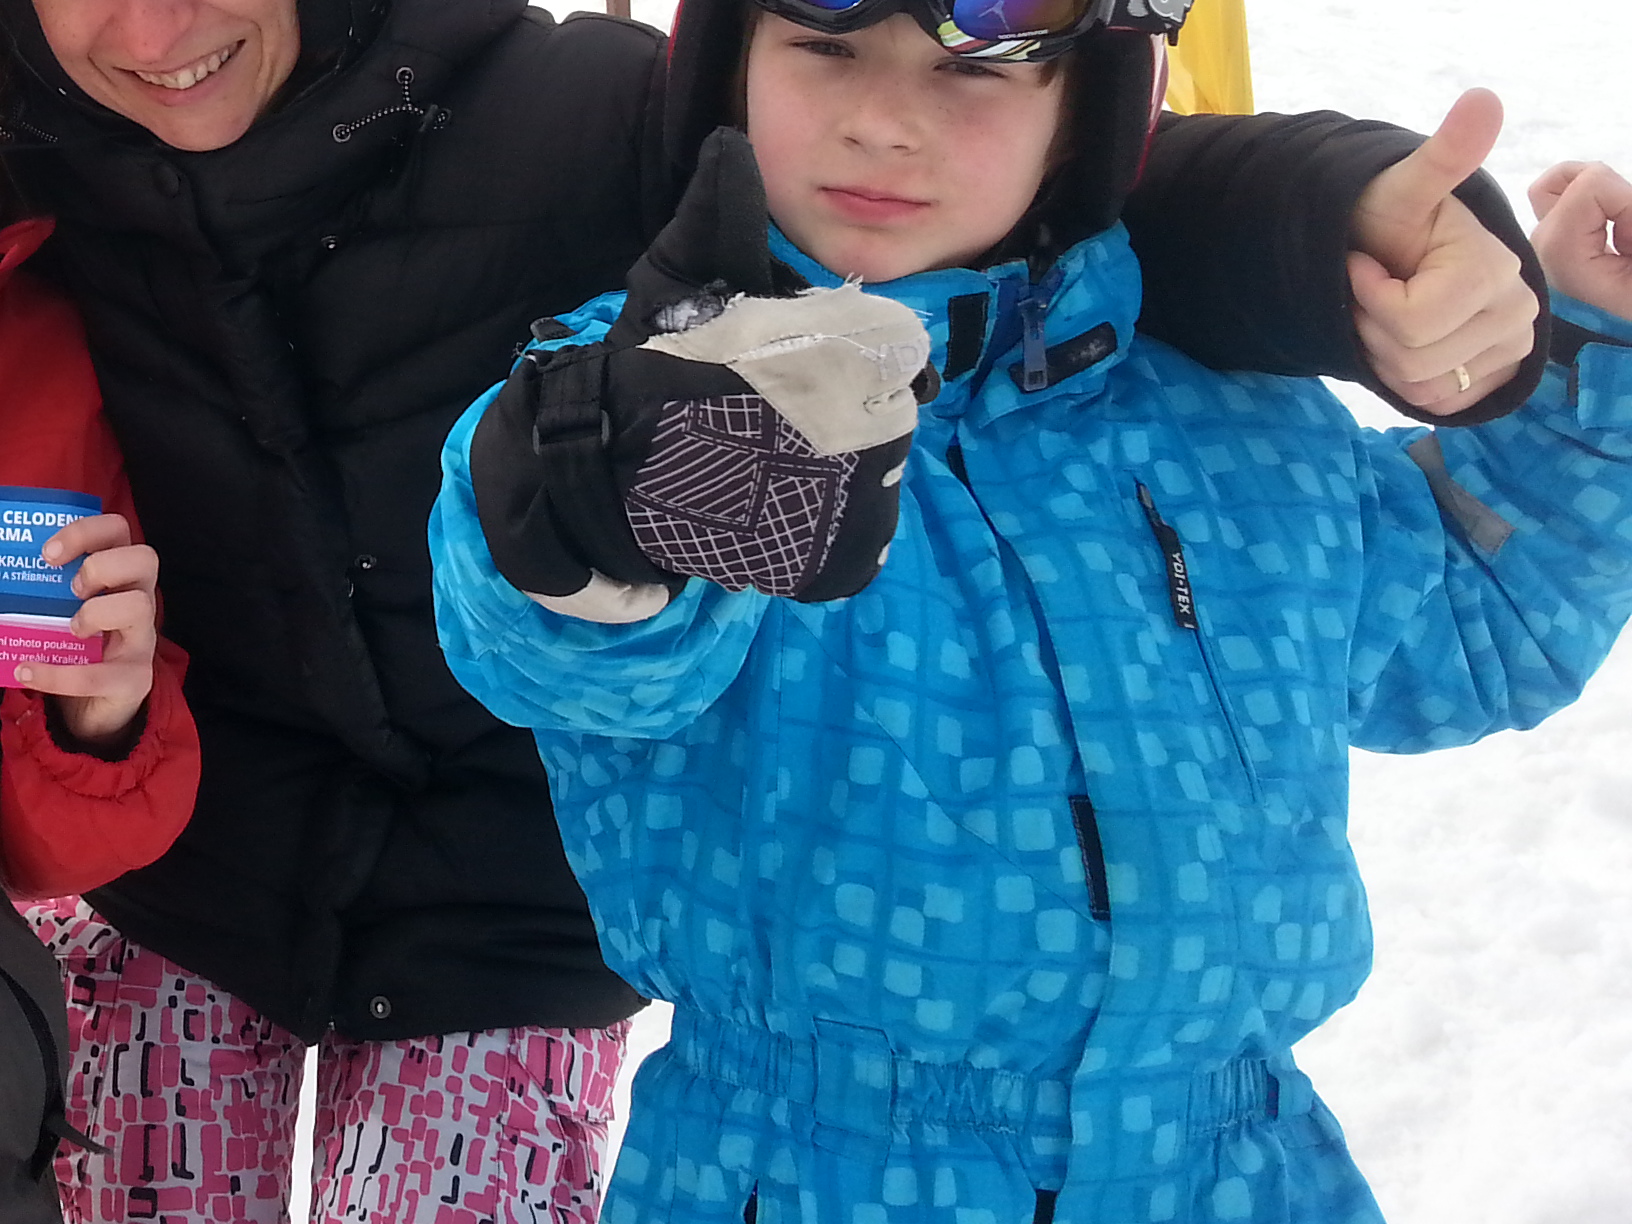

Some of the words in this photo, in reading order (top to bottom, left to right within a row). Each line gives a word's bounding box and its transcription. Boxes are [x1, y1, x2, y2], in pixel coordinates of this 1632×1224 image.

[2, 510, 85, 528] CELODEN
[3, 571, 10, 580] A
[9, 637, 41, 648] tohoto
[43, 640, 85, 651] poukazu
[11, 653, 17, 661] v
